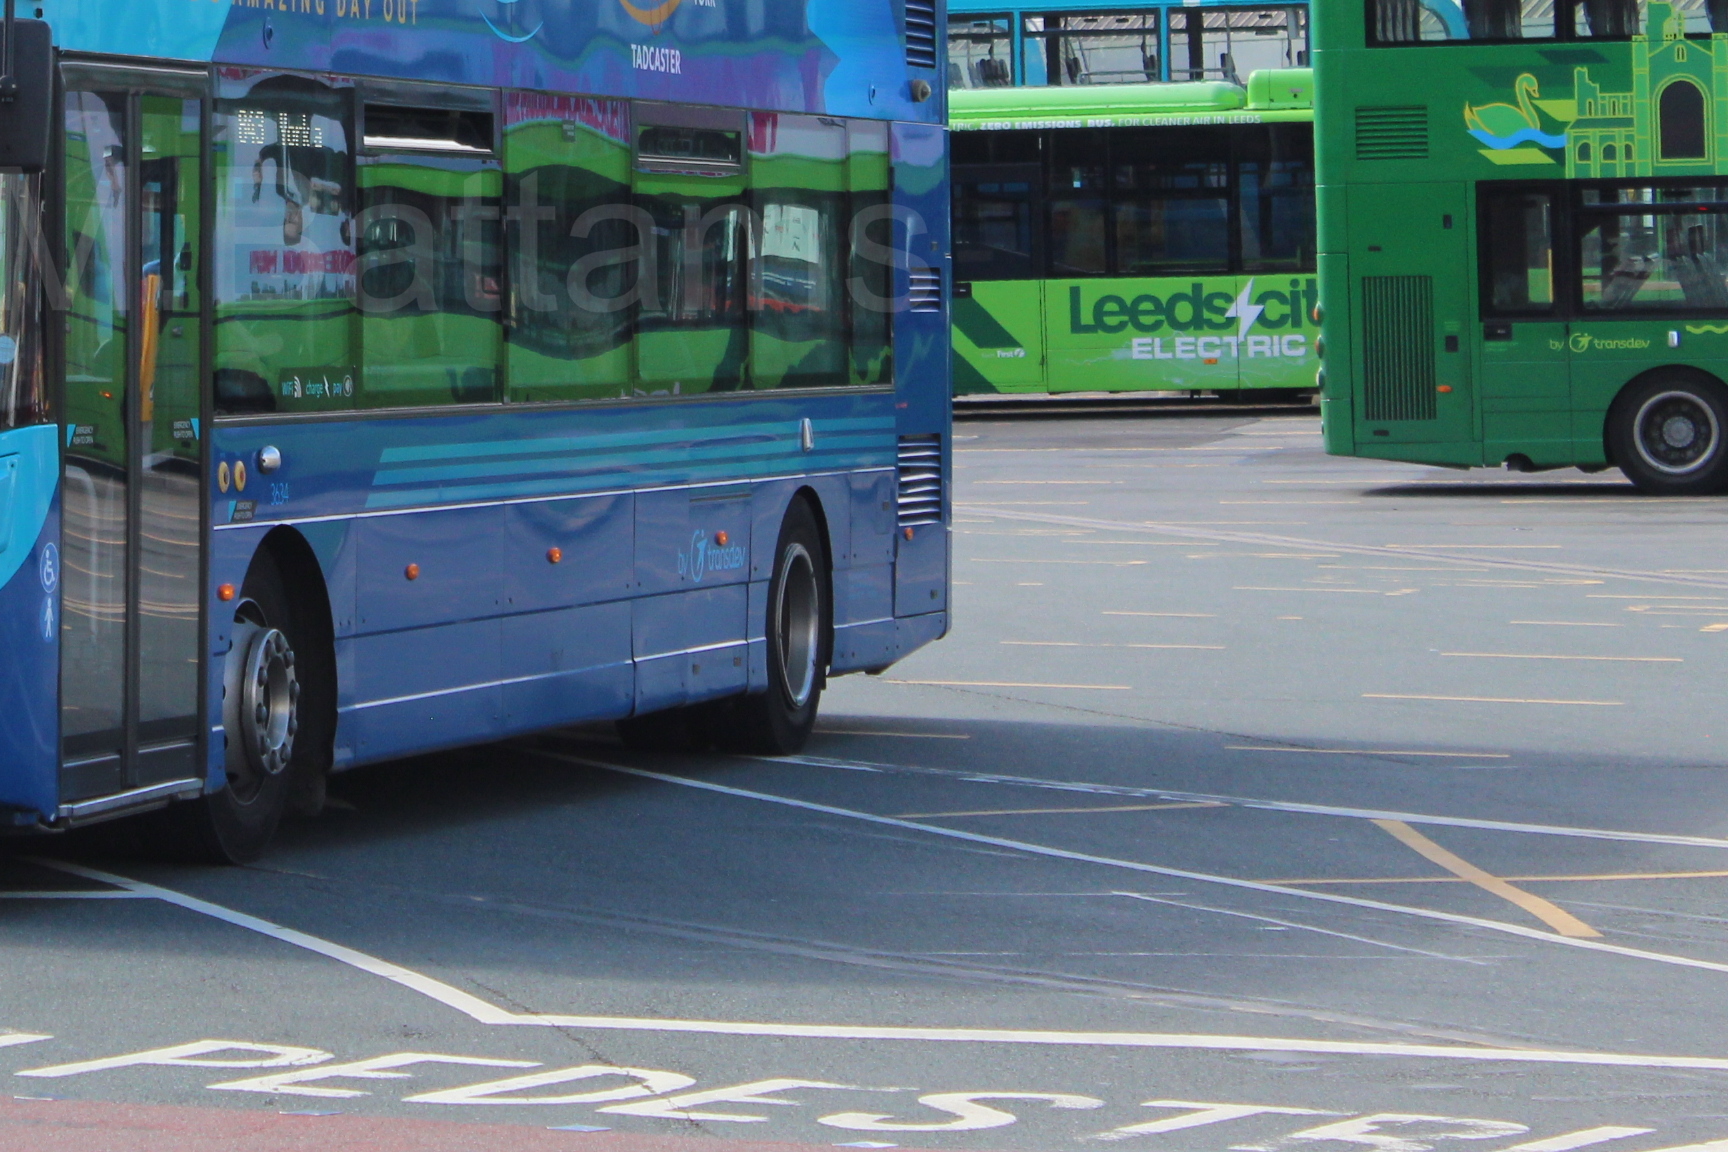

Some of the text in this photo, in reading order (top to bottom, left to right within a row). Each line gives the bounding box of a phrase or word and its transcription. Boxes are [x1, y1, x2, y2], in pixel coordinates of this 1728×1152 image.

[631, 42, 682, 75] TADCASTER
[949, 122, 978, 132] TRIC,
[979, 121, 1011, 131] ZERO
[1014, 119, 1082, 130] EMISSIONS
[1118, 118, 1140, 127] FOR
[1142, 116, 1191, 127] CLEANER
[1192, 116, 1211, 126] AIR
[1213, 115, 1225, 125] IN
[1228, 114, 1262, 124] LEEDS
[1069, 278, 1320, 335] Leeds cit
[1130, 334, 1307, 361] ELECTRIC
[1548, 337, 1651, 352] by transdev
[270, 482, 289, 506] 3634
[707, 541, 746, 571] transdev
[14, 1038, 1728, 1152] PEDESTRI
